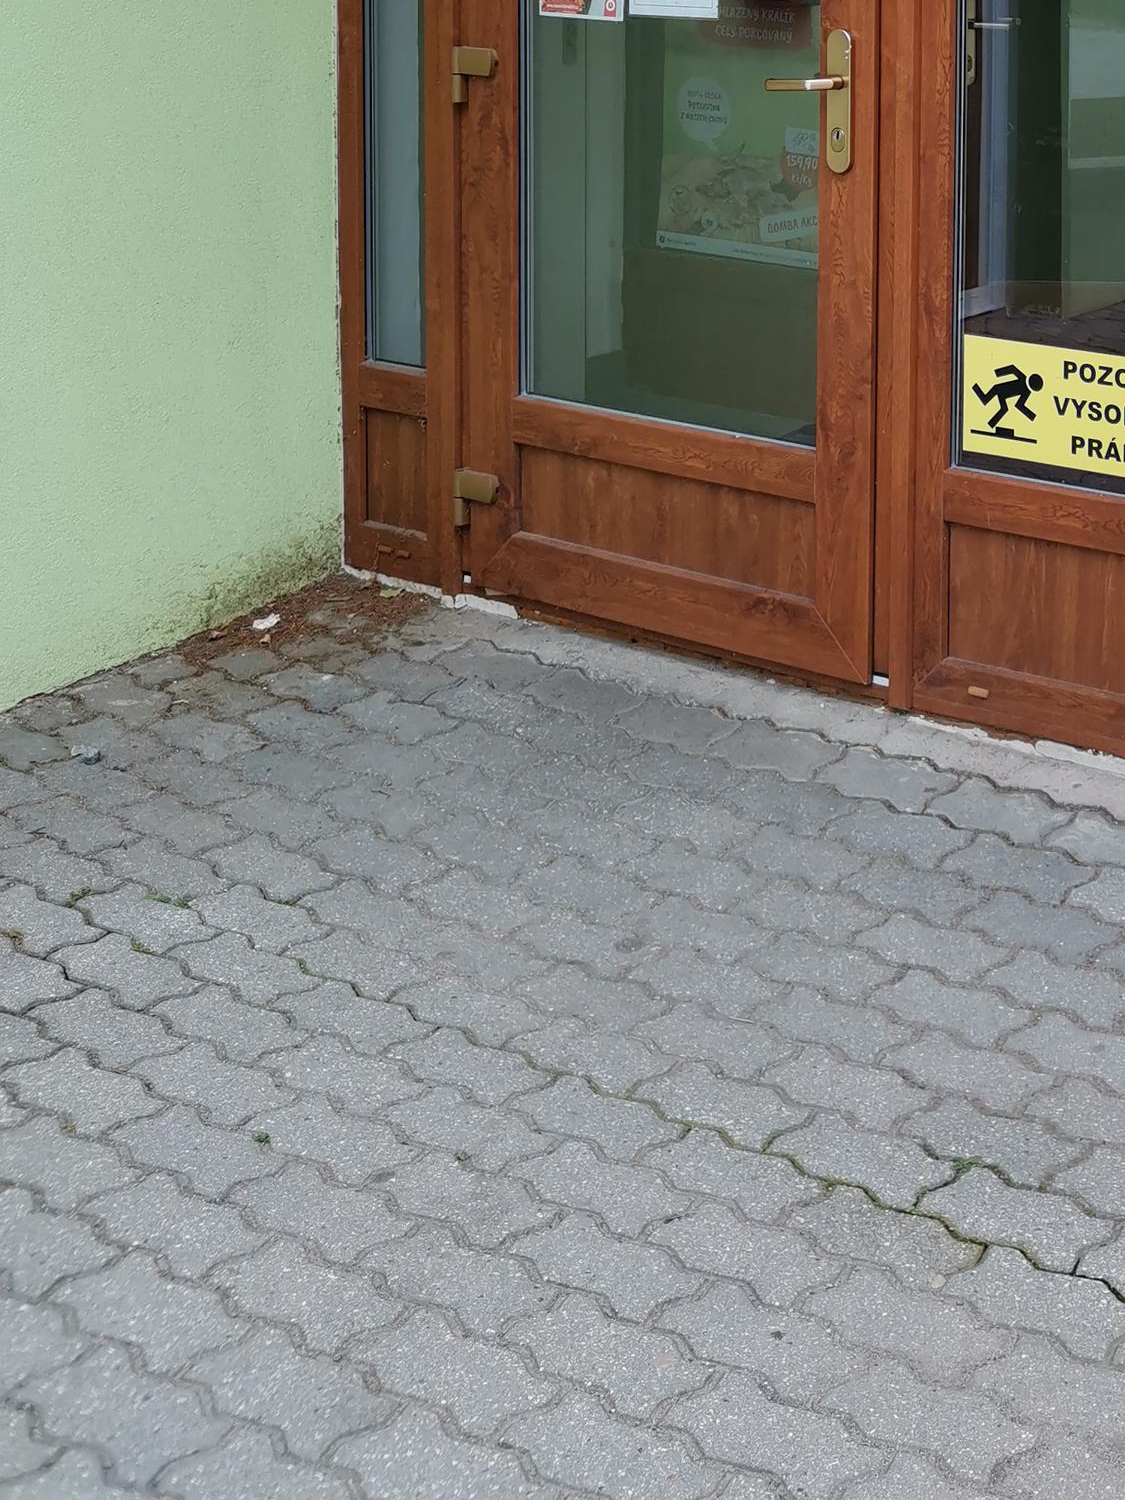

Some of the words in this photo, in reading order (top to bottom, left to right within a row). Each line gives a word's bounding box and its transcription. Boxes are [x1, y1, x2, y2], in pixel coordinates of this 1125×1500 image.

[785, 154, 818, 170] 159,90
[767, 219, 799, 235] BOMBA
[801, 215, 818, 228] AKC
